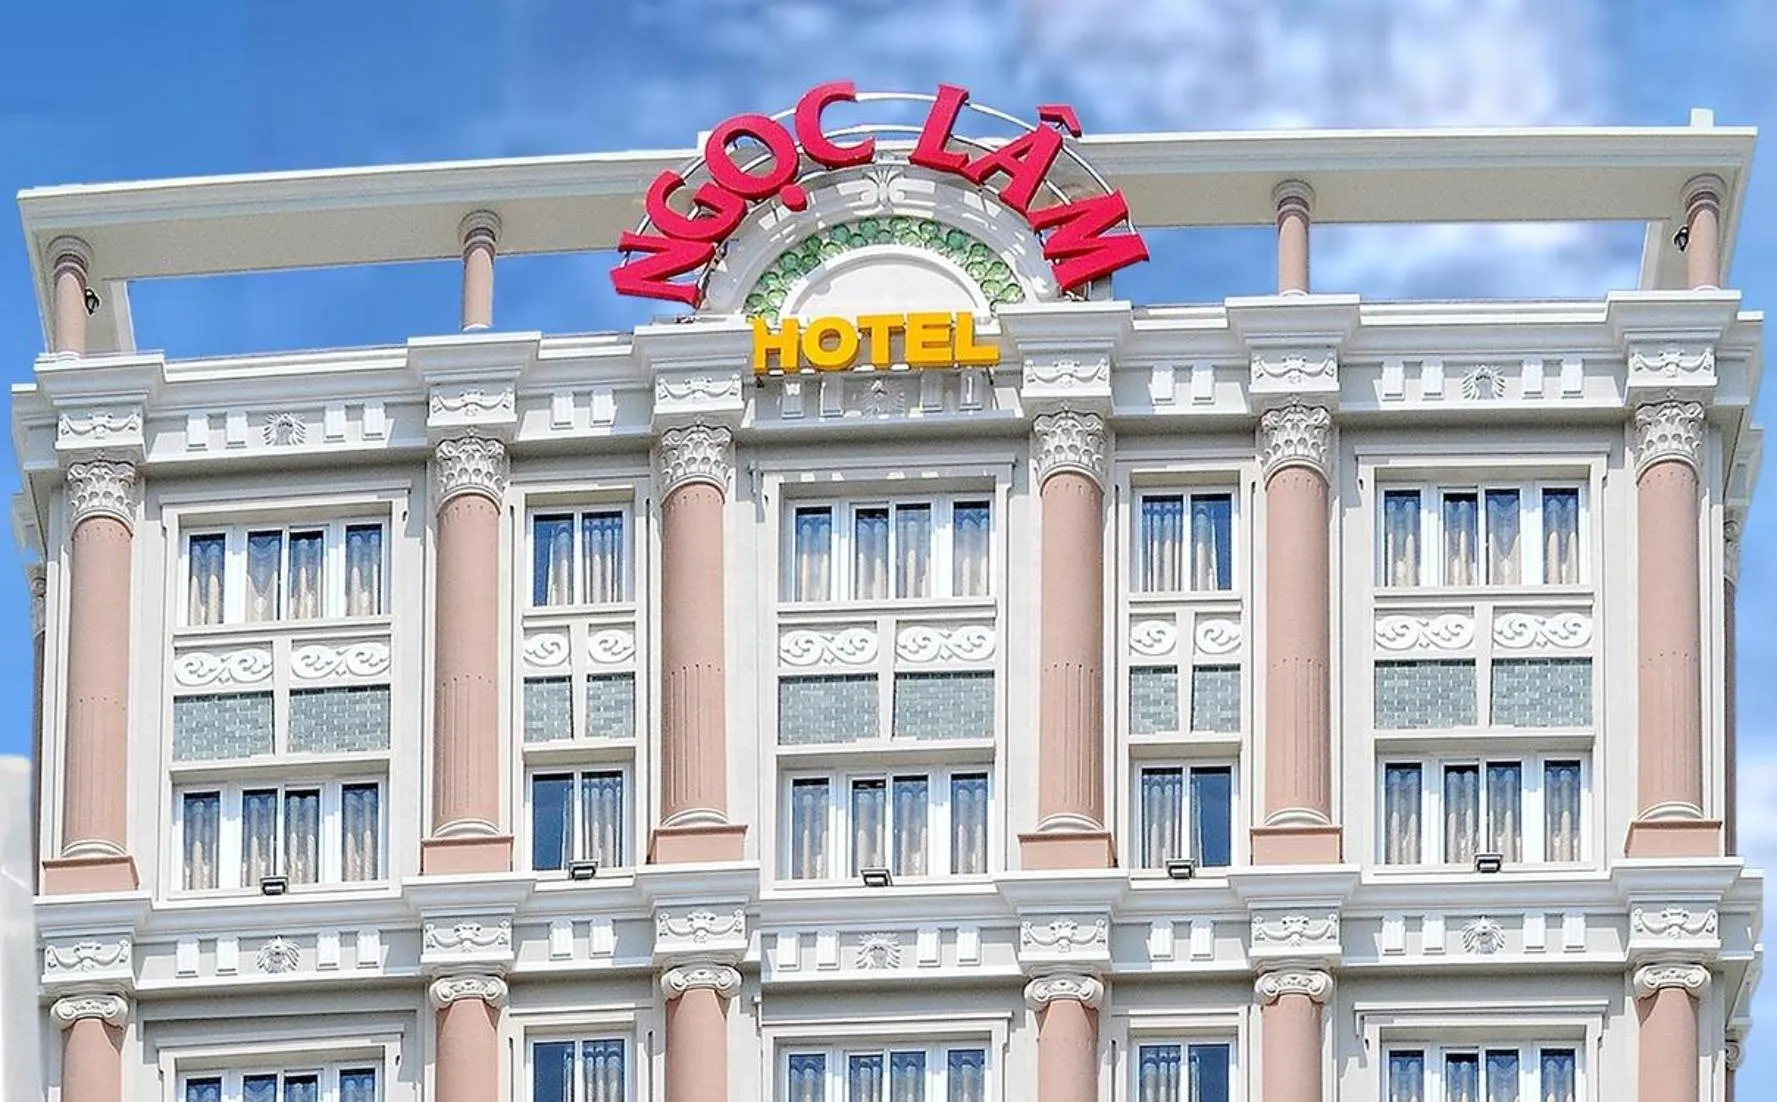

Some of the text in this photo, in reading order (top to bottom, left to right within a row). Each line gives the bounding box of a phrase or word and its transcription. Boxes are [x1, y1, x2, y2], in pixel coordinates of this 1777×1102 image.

[610, 80, 1149, 307] NGỌC LÂM
[752, 311, 999, 376] HOTEL
